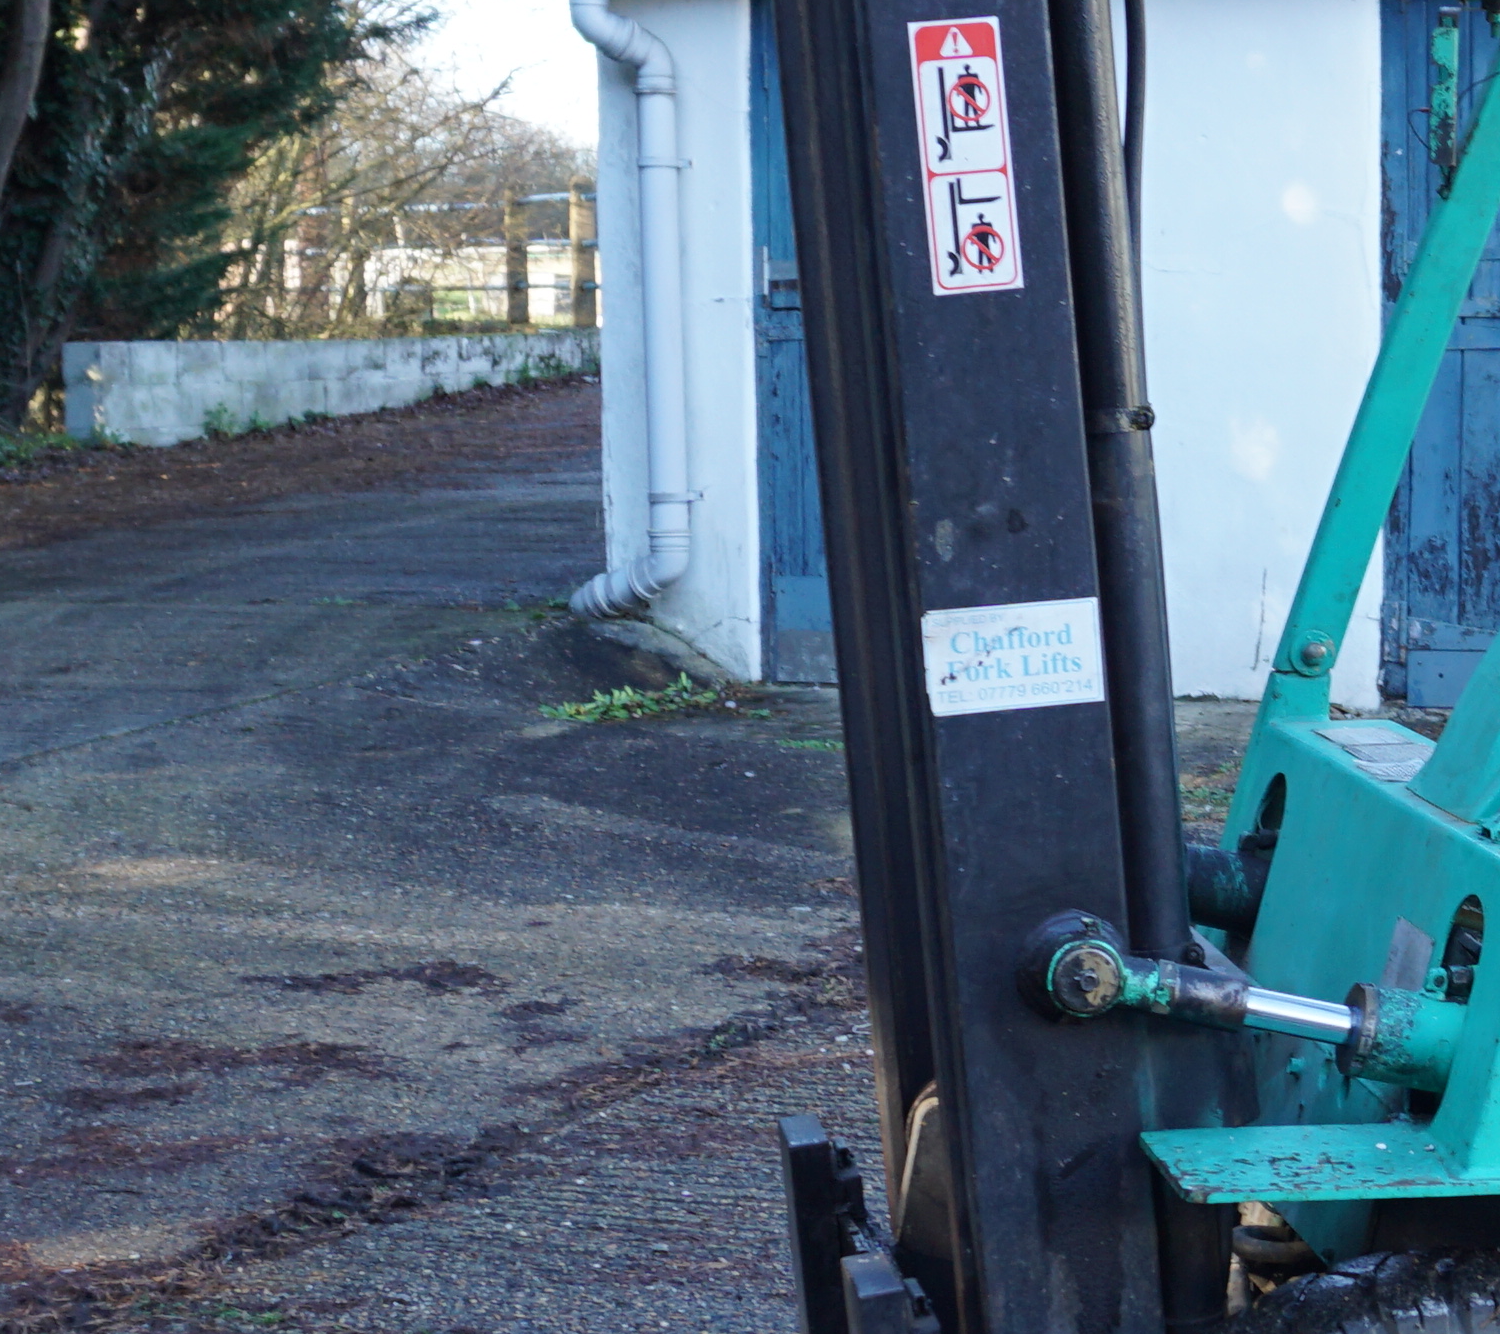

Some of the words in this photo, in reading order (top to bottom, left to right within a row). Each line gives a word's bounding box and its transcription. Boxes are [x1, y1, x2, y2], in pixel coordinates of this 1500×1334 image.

[951, 624, 1072, 654] Chafford
[947, 658, 1013, 683] Fork
[1021, 652, 1082, 676] Lifts
[978, 684, 1027, 701] 07779
